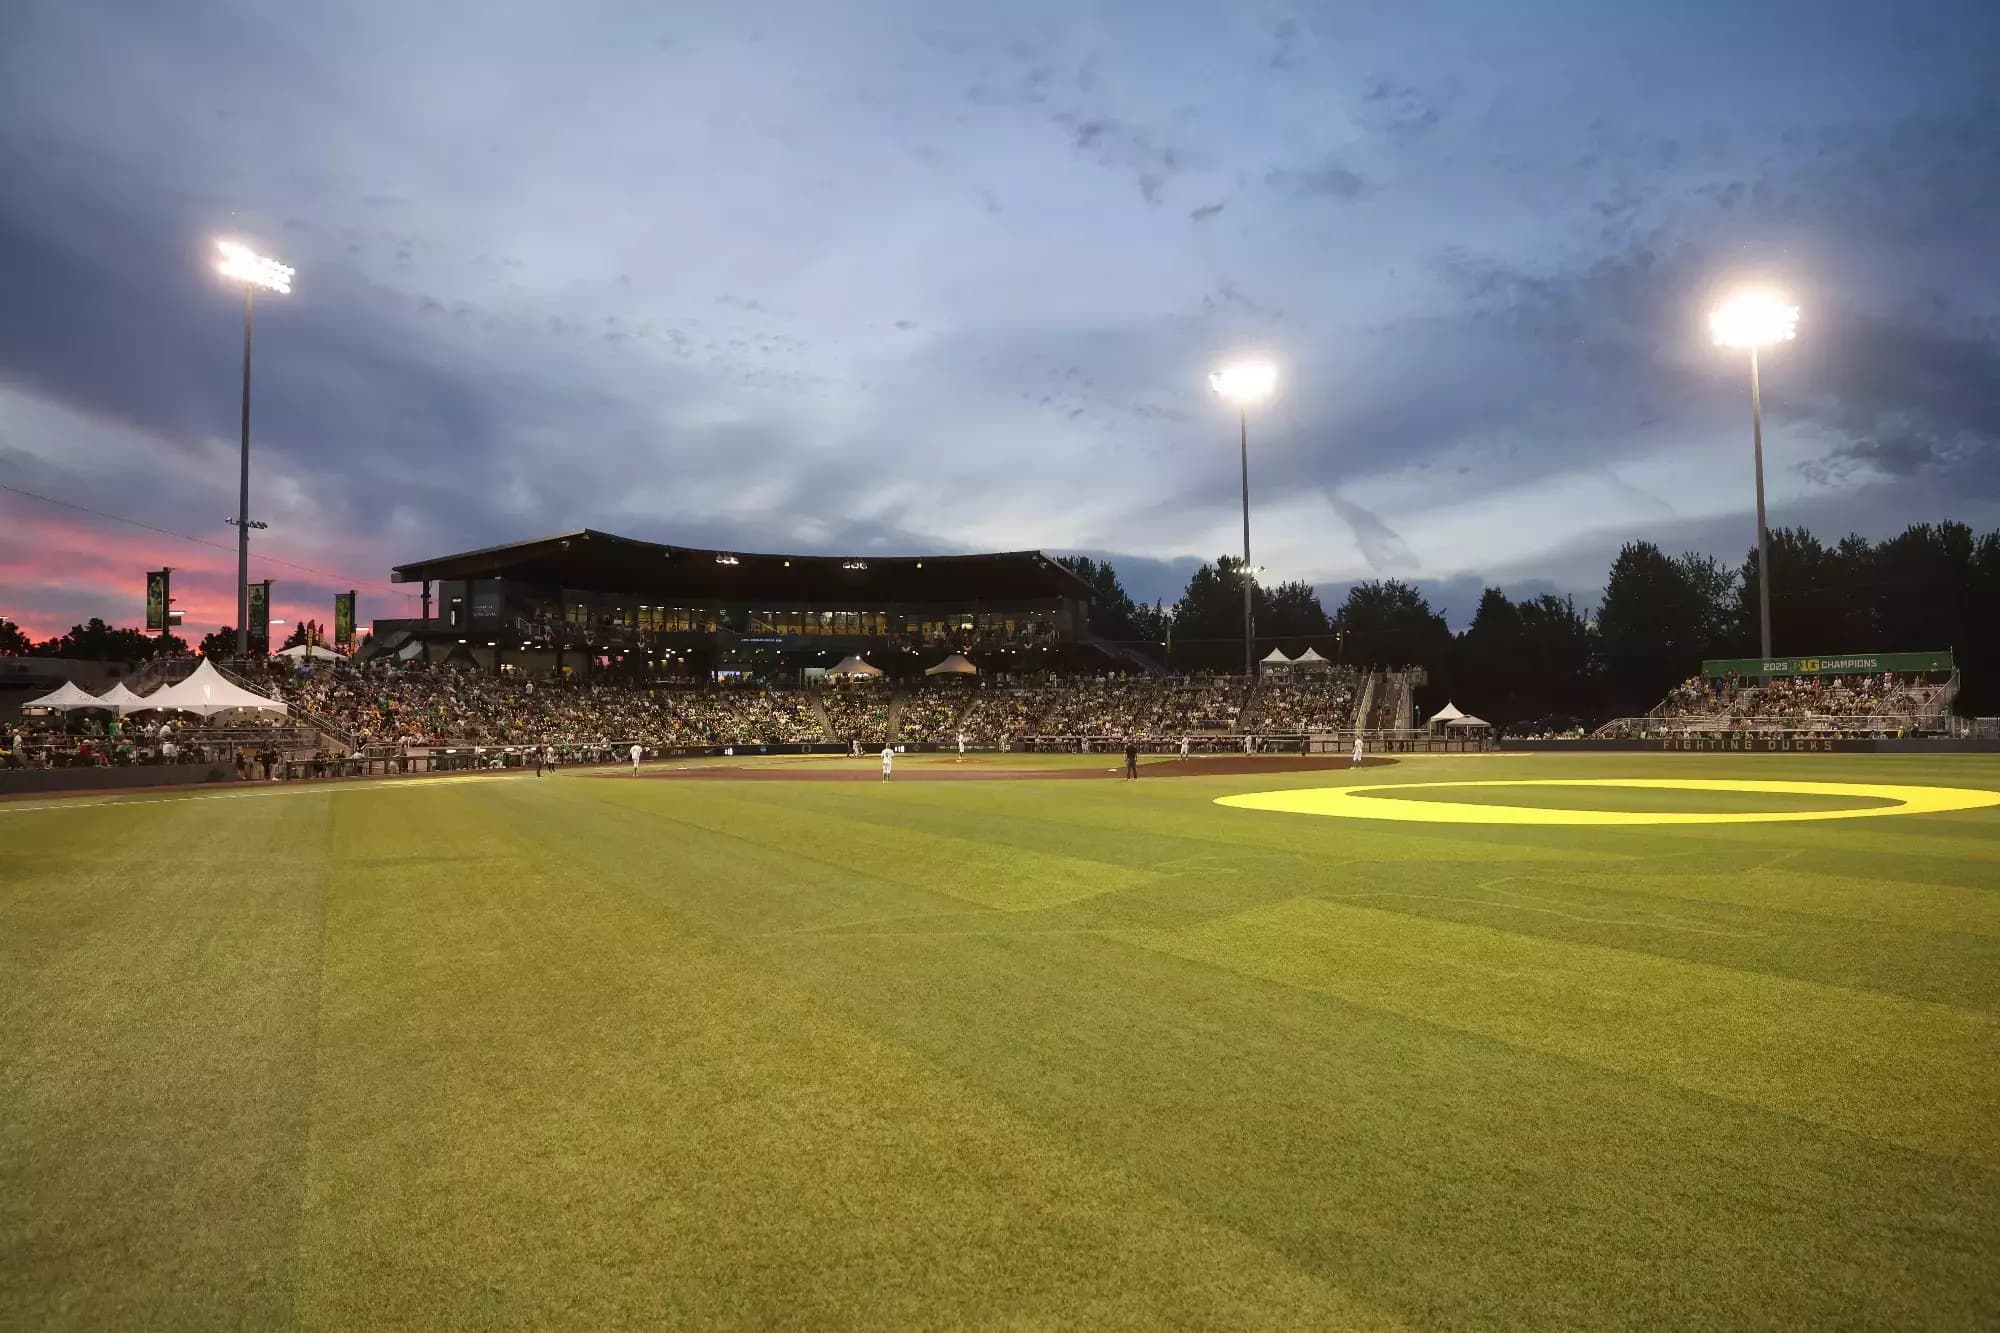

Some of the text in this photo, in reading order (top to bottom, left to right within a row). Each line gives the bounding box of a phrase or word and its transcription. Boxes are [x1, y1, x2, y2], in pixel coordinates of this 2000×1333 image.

[1763, 662, 1788, 671] 2025
[1821, 659, 1877, 669] CHAMPIONS
[1663, 740, 1832, 751] FIGHTING DUCKS
